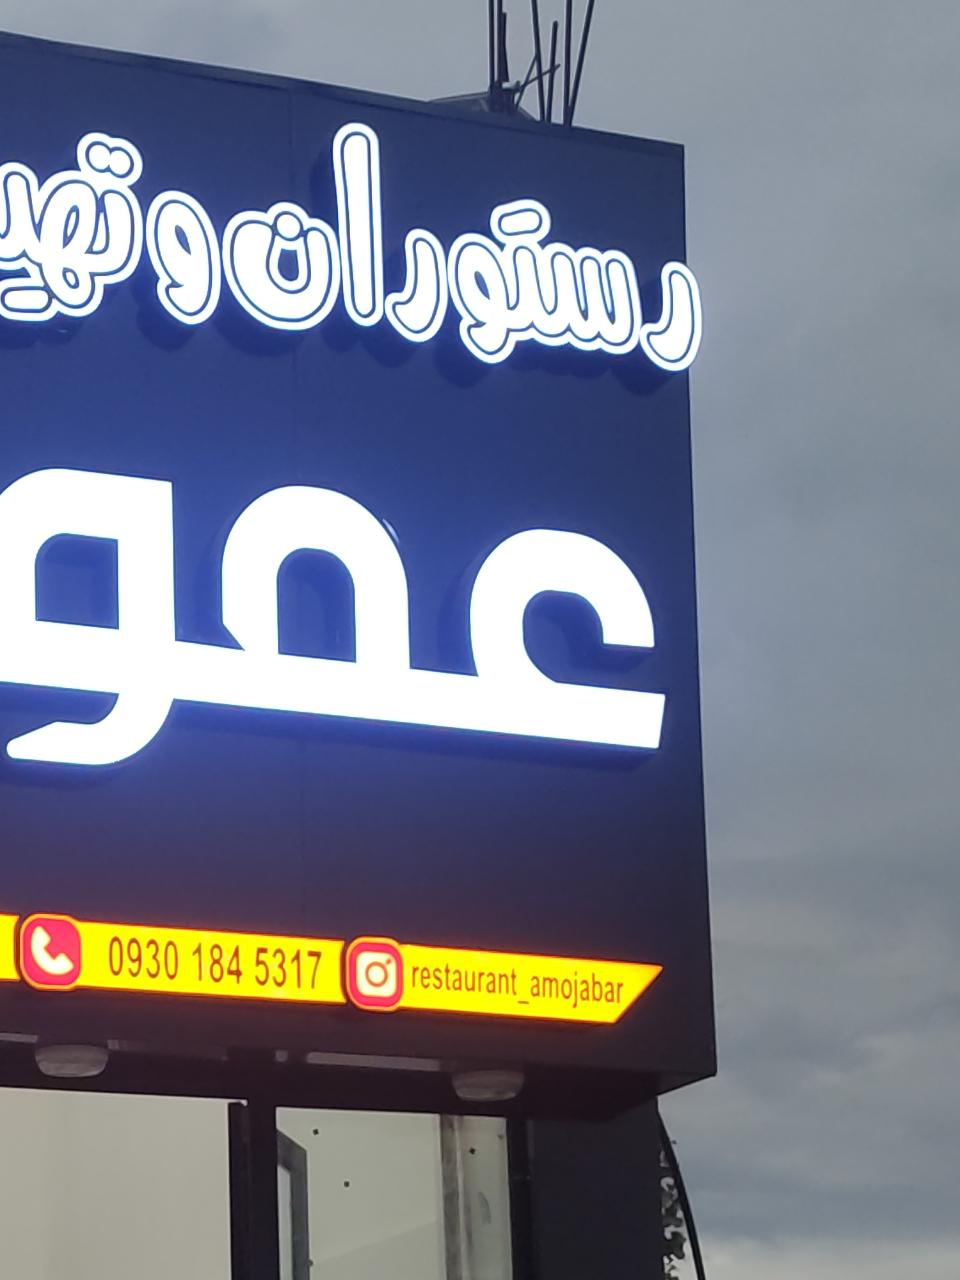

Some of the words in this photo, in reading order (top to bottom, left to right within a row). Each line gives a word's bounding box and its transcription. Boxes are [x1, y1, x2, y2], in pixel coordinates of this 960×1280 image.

[145, 190, 222, 326] و
[222, 122, 702, 372] رستوران
[108, 935, 179, 981] 0930
[192, 942, 243, 985] 184
[255, 946, 323, 990] 5317
[411, 962, 624, 1009] restaurant_amojabar
